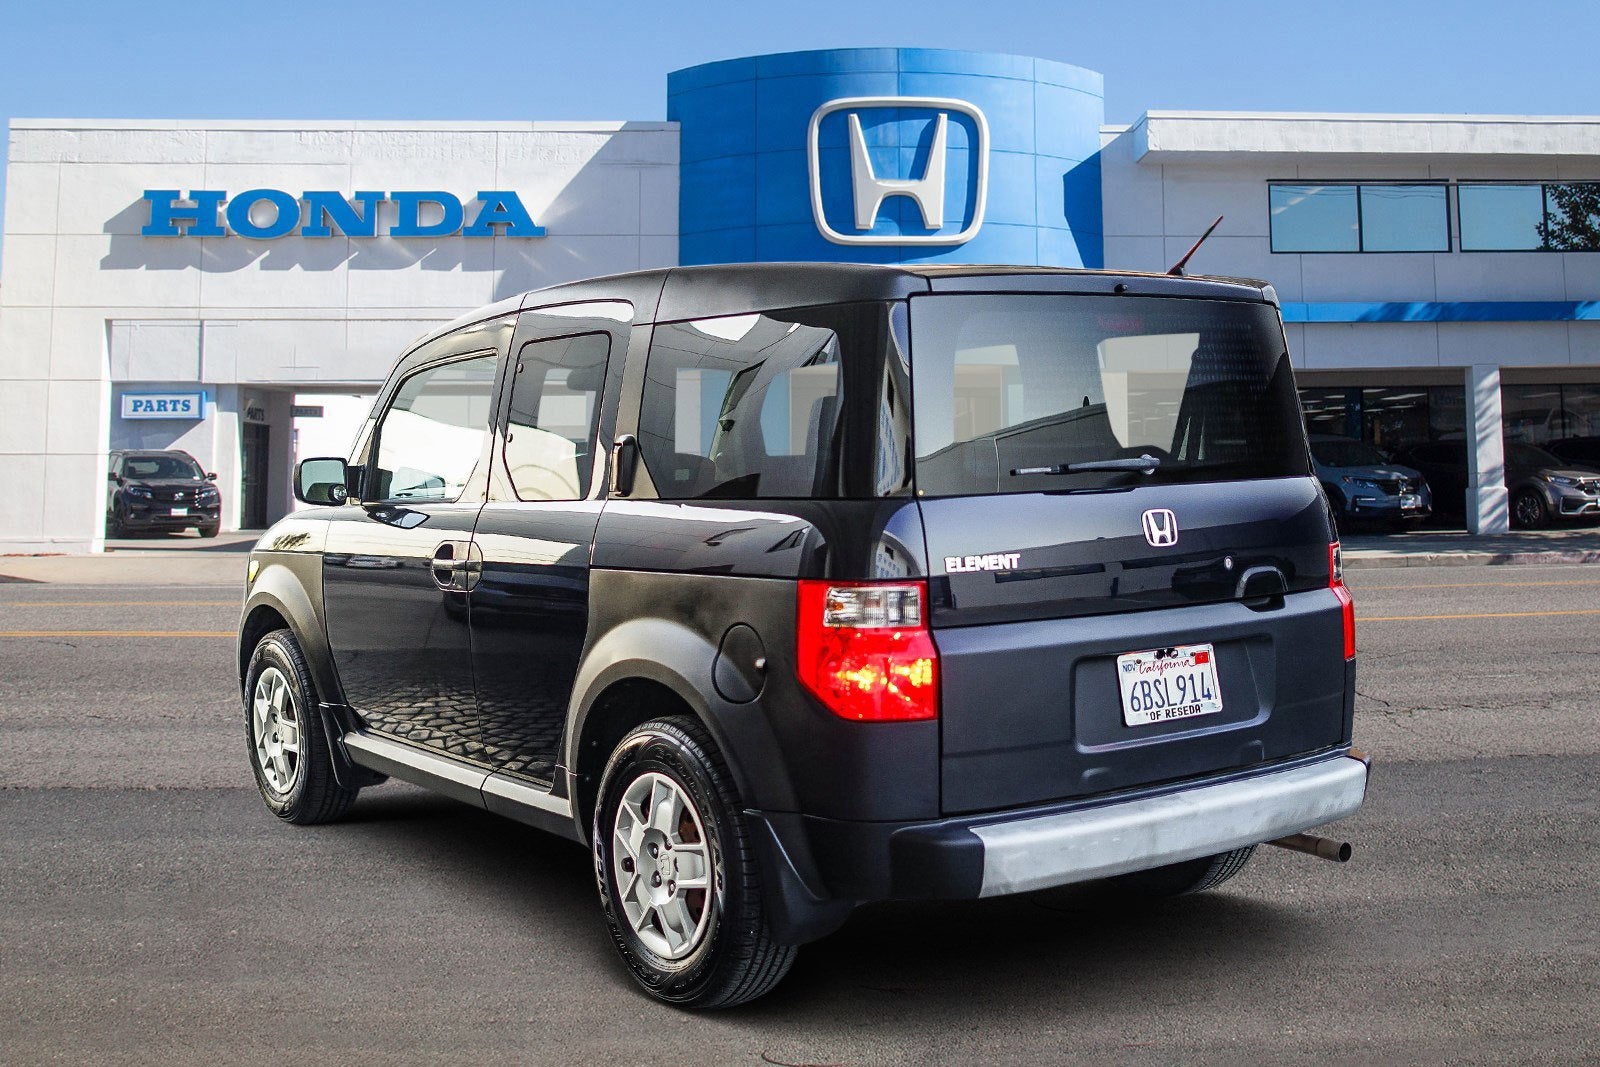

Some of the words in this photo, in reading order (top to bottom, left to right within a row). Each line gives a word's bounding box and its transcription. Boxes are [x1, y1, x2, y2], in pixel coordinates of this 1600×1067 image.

[141, 189, 547, 239] HONDA
[131, 399, 191, 413] PARTS
[246, 407, 264, 422] PARTS
[944, 553, 1021, 573] ELEMENT
[1138, 659, 1194, 676] California
[1130, 671, 1212, 712] 6BSL914
[1149, 711, 1162, 721] OF
[1165, 704, 1201, 719] RESEDA
